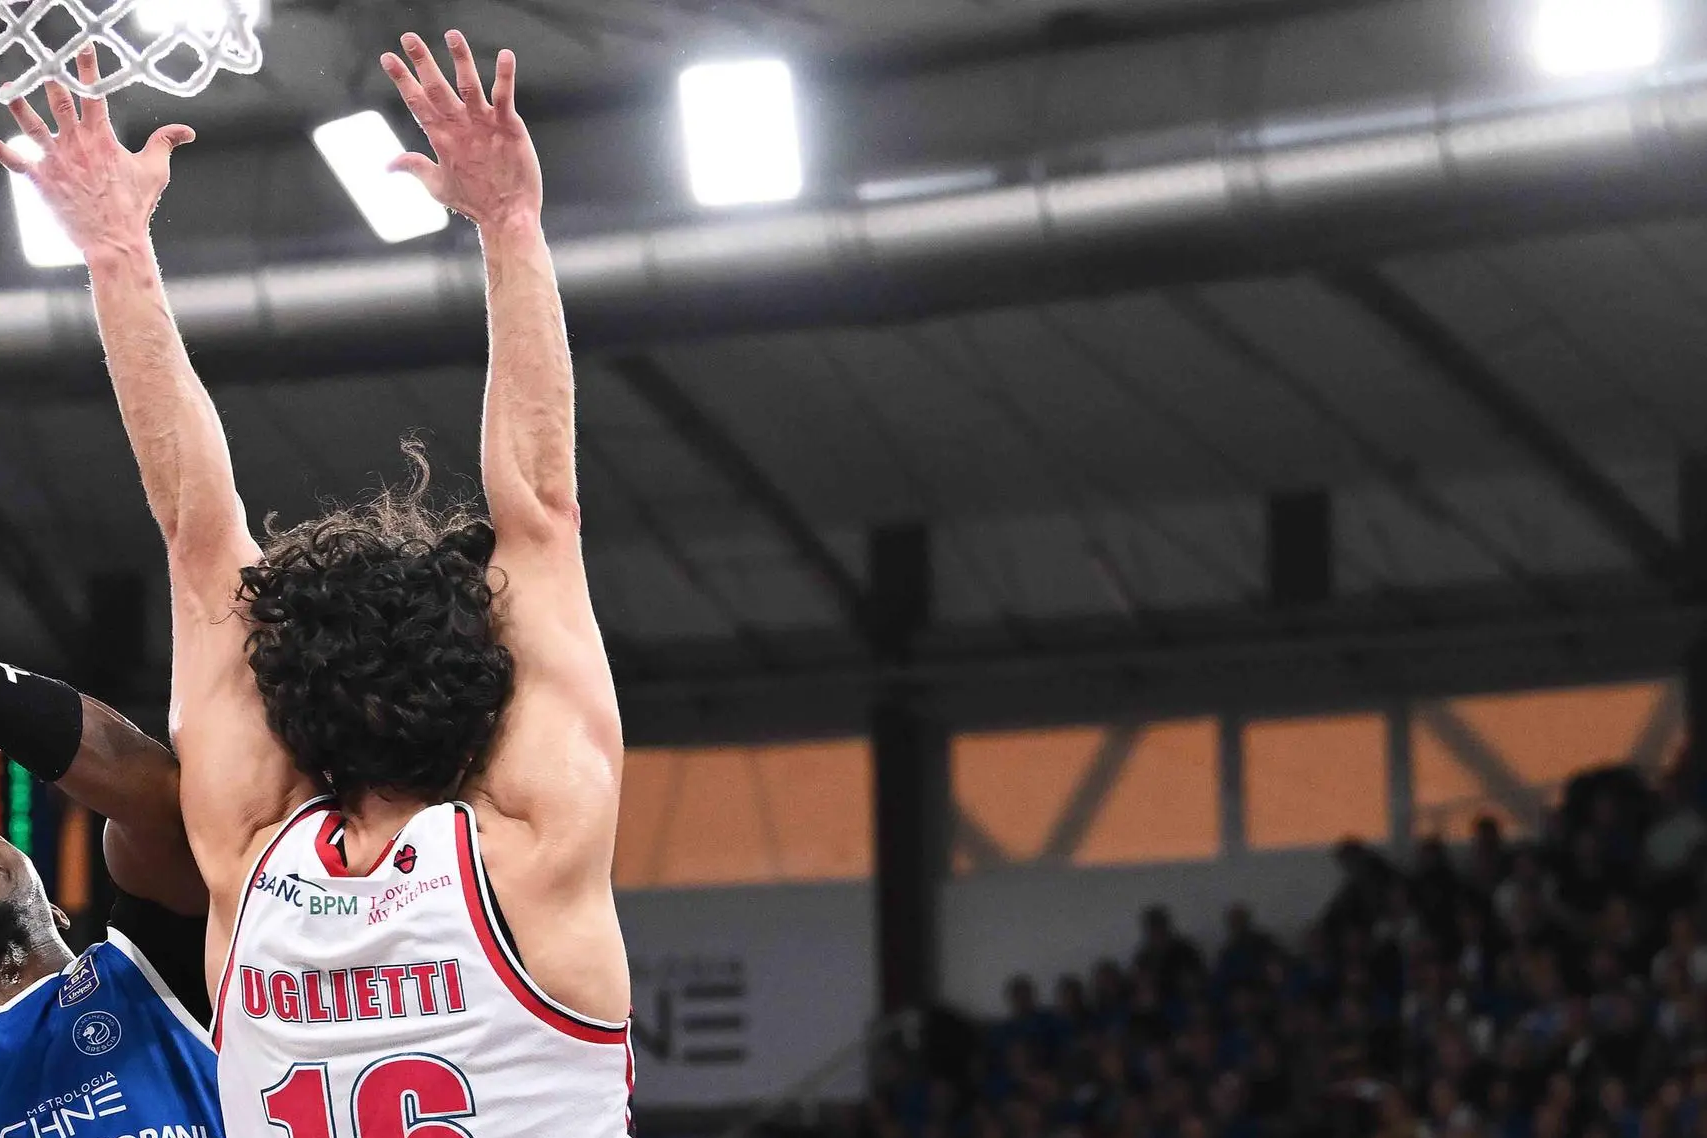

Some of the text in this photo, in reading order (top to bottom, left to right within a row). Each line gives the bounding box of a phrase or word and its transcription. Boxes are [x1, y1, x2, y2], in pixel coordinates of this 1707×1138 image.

[254, 872, 358, 915] BANC BPM
[367, 908, 390, 926] My
[64, 967, 90, 991] LBA
[68, 980, 93, 1001] Unipol
[240, 958, 467, 1023] UGLIETTI
[84, 1035, 117, 1053] BRESCIA
[26, 1071, 116, 1119] METROLOGIA
